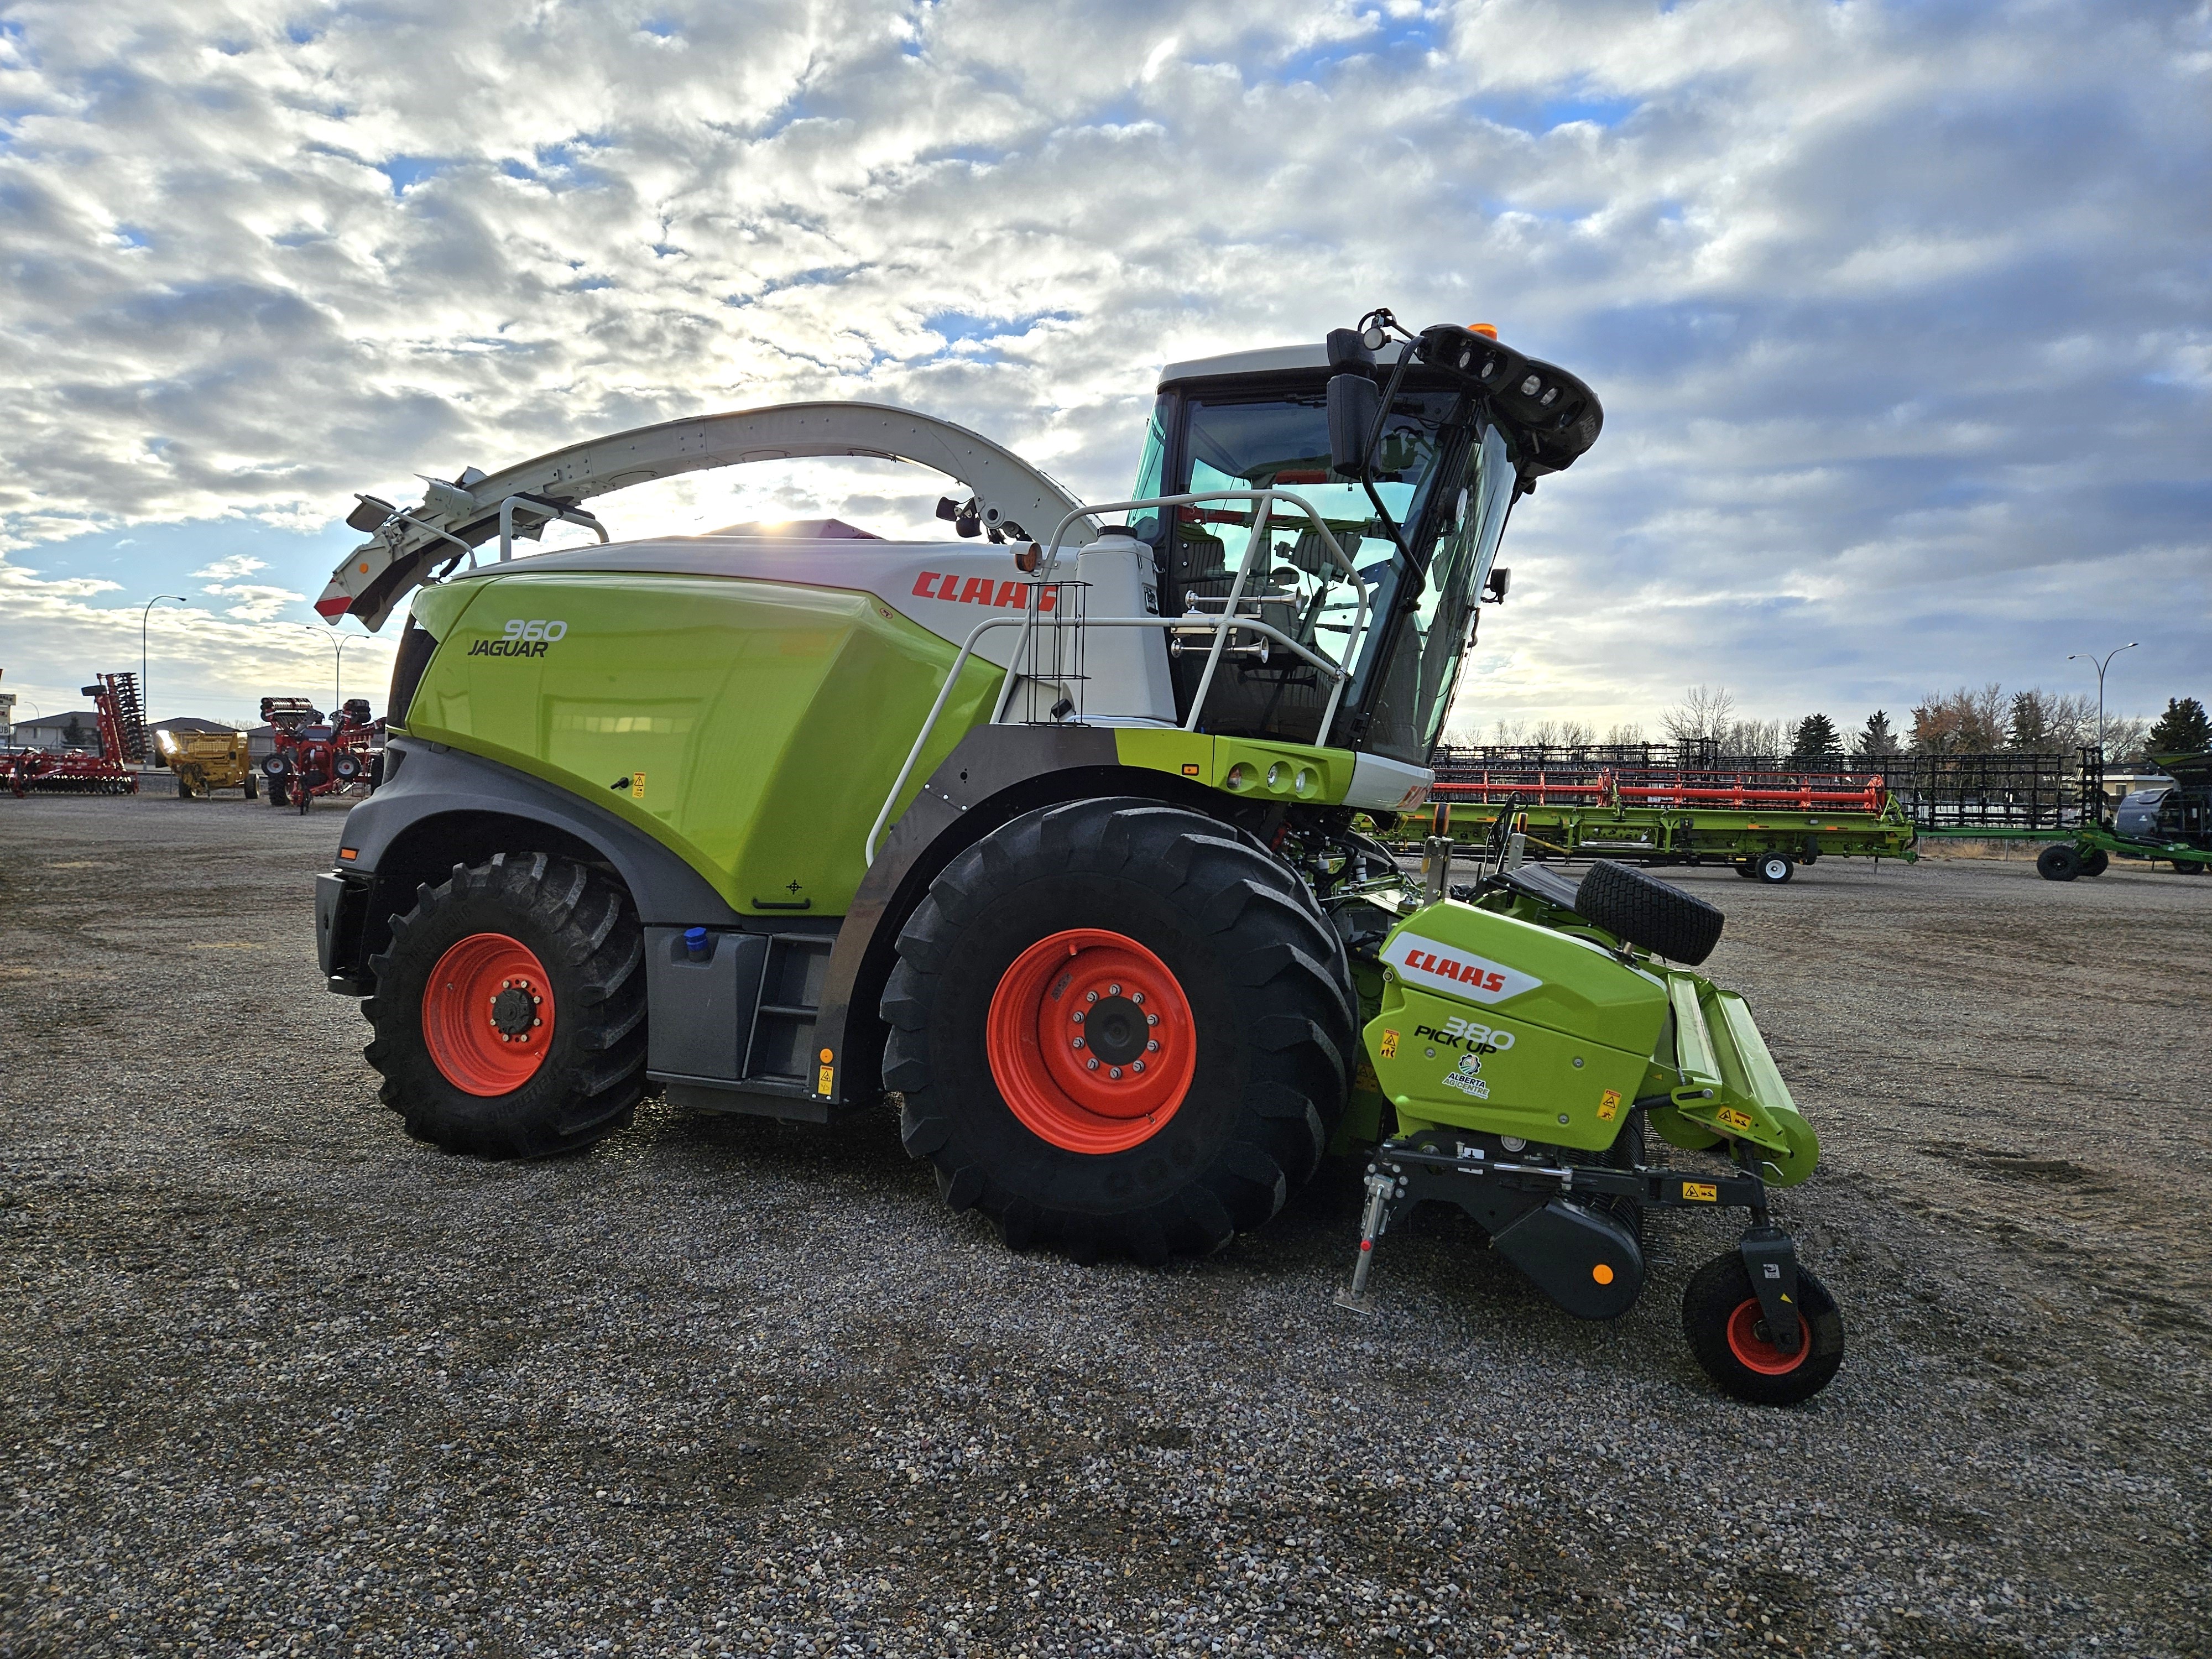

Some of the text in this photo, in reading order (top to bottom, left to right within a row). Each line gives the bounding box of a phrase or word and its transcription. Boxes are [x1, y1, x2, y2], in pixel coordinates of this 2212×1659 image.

[912, 571, 1059, 612] CLAAS
[502, 619, 567, 641] 960
[467, 640, 549, 658] JAGUAR
[1405, 950, 1506, 992] CLAAS
[1414, 1025, 1497, 1055] PICK UP
[1442, 1016, 1515, 1050] 380
[1448, 1073, 1485, 1088] ALBERTA
[1457, 1081, 1488, 1095] CENTRE
